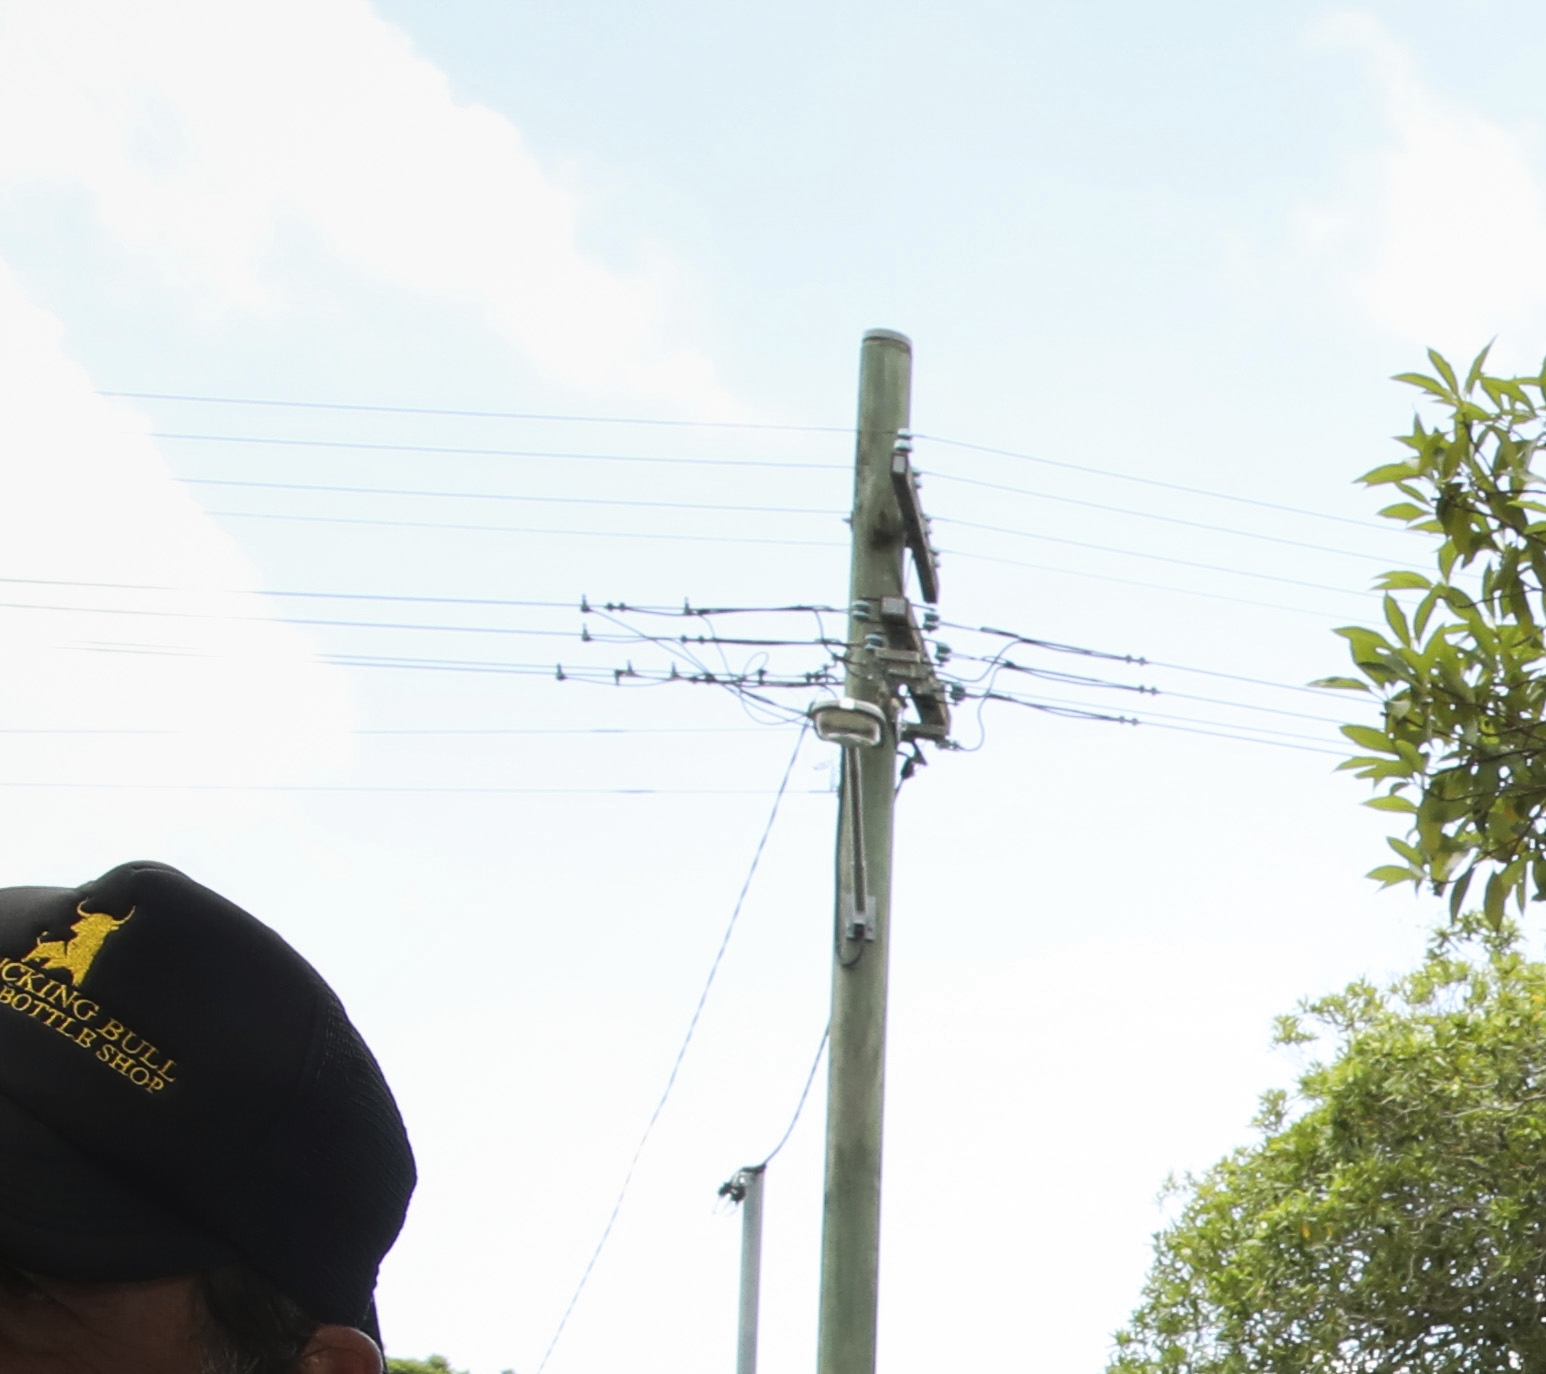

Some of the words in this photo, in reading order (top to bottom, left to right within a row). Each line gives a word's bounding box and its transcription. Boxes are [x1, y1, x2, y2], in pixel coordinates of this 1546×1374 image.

[0, 985, 97, 1048] BOTTLE
[96, 1044, 164, 1093] SHOP
[96, 1017, 177, 1082] BULL
